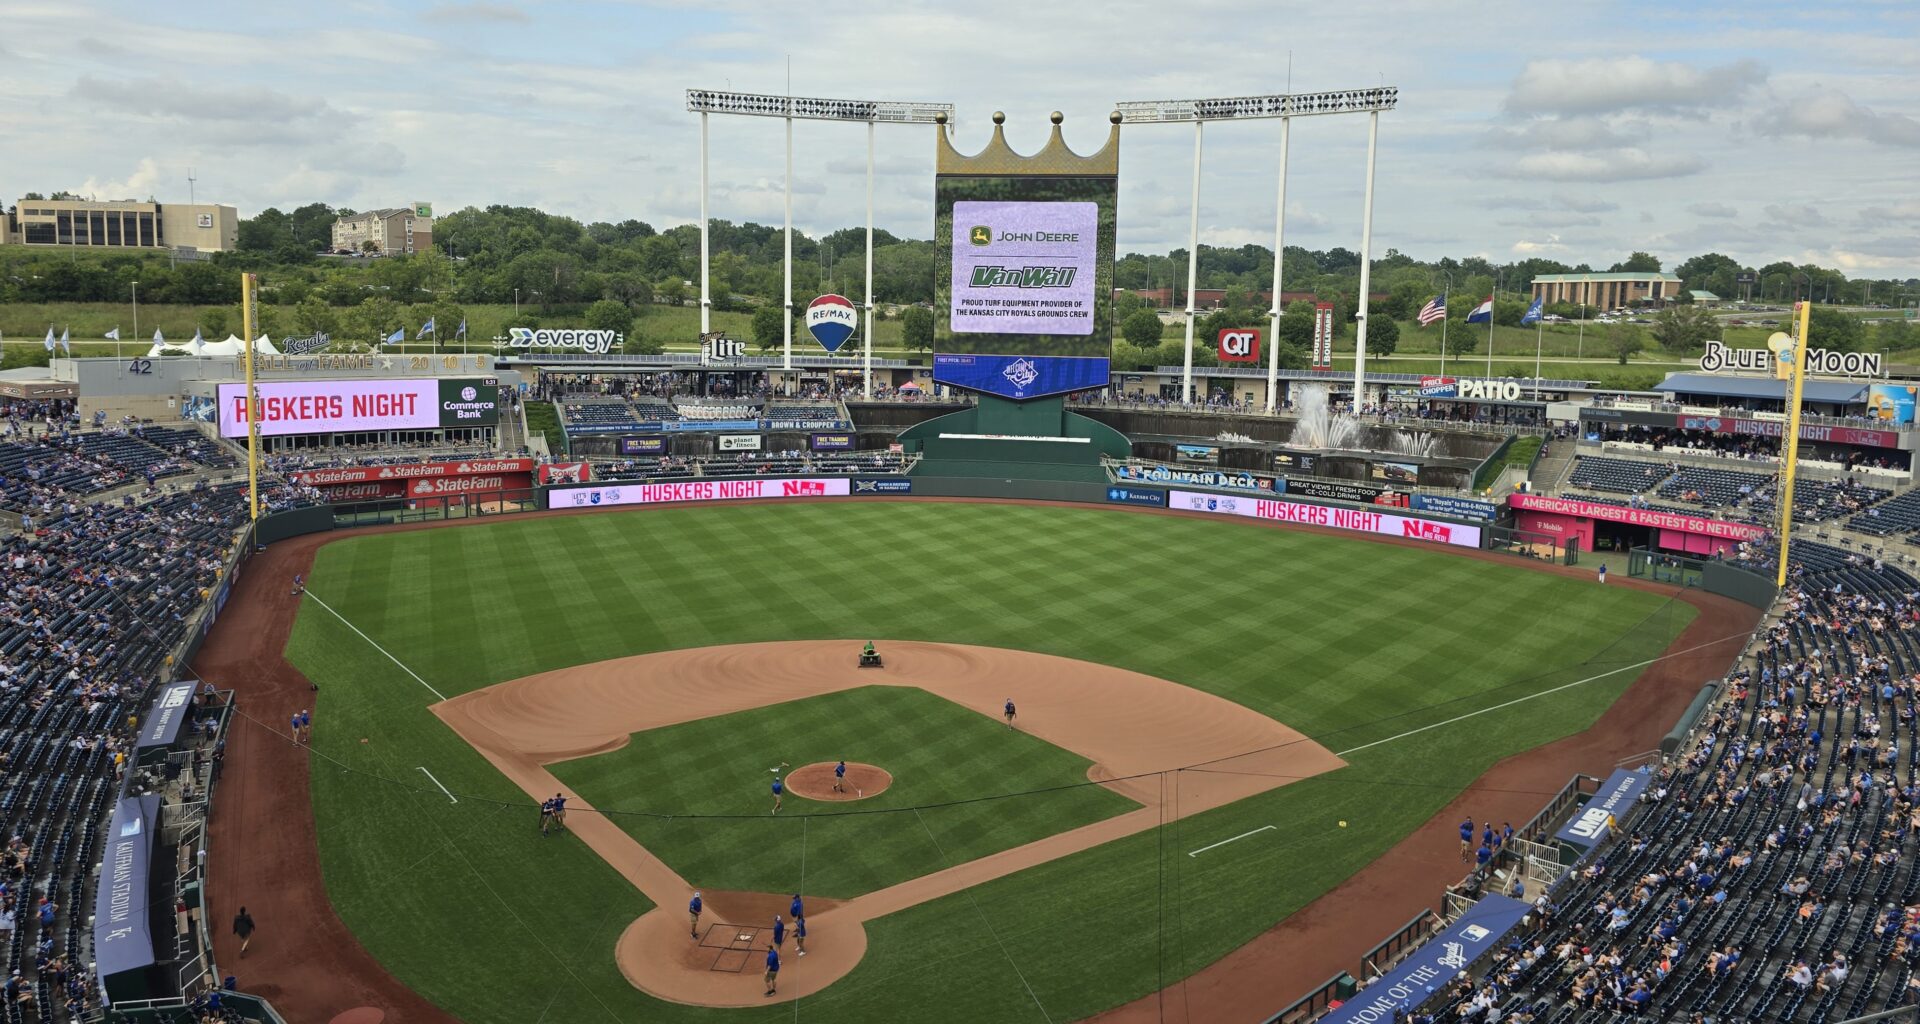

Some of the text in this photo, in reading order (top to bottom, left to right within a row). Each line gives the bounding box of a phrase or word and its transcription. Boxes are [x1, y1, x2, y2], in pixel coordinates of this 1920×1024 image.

[996, 231, 1080, 242] JOHN DEERE
[1002, 299, 1039, 307] EQUIPMENT
[1074, 300, 1083, 308] OF
[812, 309, 851, 321] RE/MAX
[956, 308, 968, 316] THE
[995, 309, 1010, 317] CITY
[1011, 309, 1036, 317] ROYALS
[1069, 310, 1088, 318] CREW
[283, 330, 331, 355] Royals
[535, 330, 613, 351] evergy
[1222, 332, 1254, 356] QT
[710, 338, 746, 360] Lite
[238, 355, 296, 371] HALL
[317, 354, 374, 371] FAME
[410, 356, 429, 370] 20
[442, 356, 458, 369] 10
[475, 355, 485, 369] 5
[1700, 341, 1769, 373] BLUE
[1804, 348, 1882, 375] MOON
[129, 360, 153, 374] 42
[1423, 378, 1442, 386] PRICE
[1421, 384, 1455, 395] CHOPPER
[1458, 379, 1521, 400] PATIO
[235, 394, 343, 422] HUSKERS
[352, 392, 418, 418] NIGHT
[443, 401, 495, 411] Commerce
[457, 410, 482, 419] Bank
[771, 421, 835, 429] BROWN & CROUPPEN
[1734, 419, 1782, 437] HUSKER
[733, 437, 754, 445] planet
[552, 469, 577, 478] SONIC
[1143, 469, 1257, 488] FOUNTAIN DECK
[642, 482, 713, 502] HUSKERS
[719, 480, 764, 498] NIGHT
[1289, 481, 1377, 496] GREAT VIEWS FRESH FOOD
[1305, 488, 1361, 500] ICE-COLD DRINKS
[1149, 494, 1160, 502] City
[1256, 500, 1382, 532] HUSKERS NIGHT
[1522, 497, 1765, 540] AMERICA'S LARGEST & FASTEST 5G NETWORK
[1432, 525, 1441, 533] GO
[1543, 522, 1563, 532] Mobile
[1423, 531, 1433, 539] BIG
[1568, 807, 1610, 837] UMB
[110, 840, 134, 923] KAUFFMAN STADIUM
[1437, 941, 1467, 969] Royals
[1347, 964, 1440, 1024] HOME OF THE
